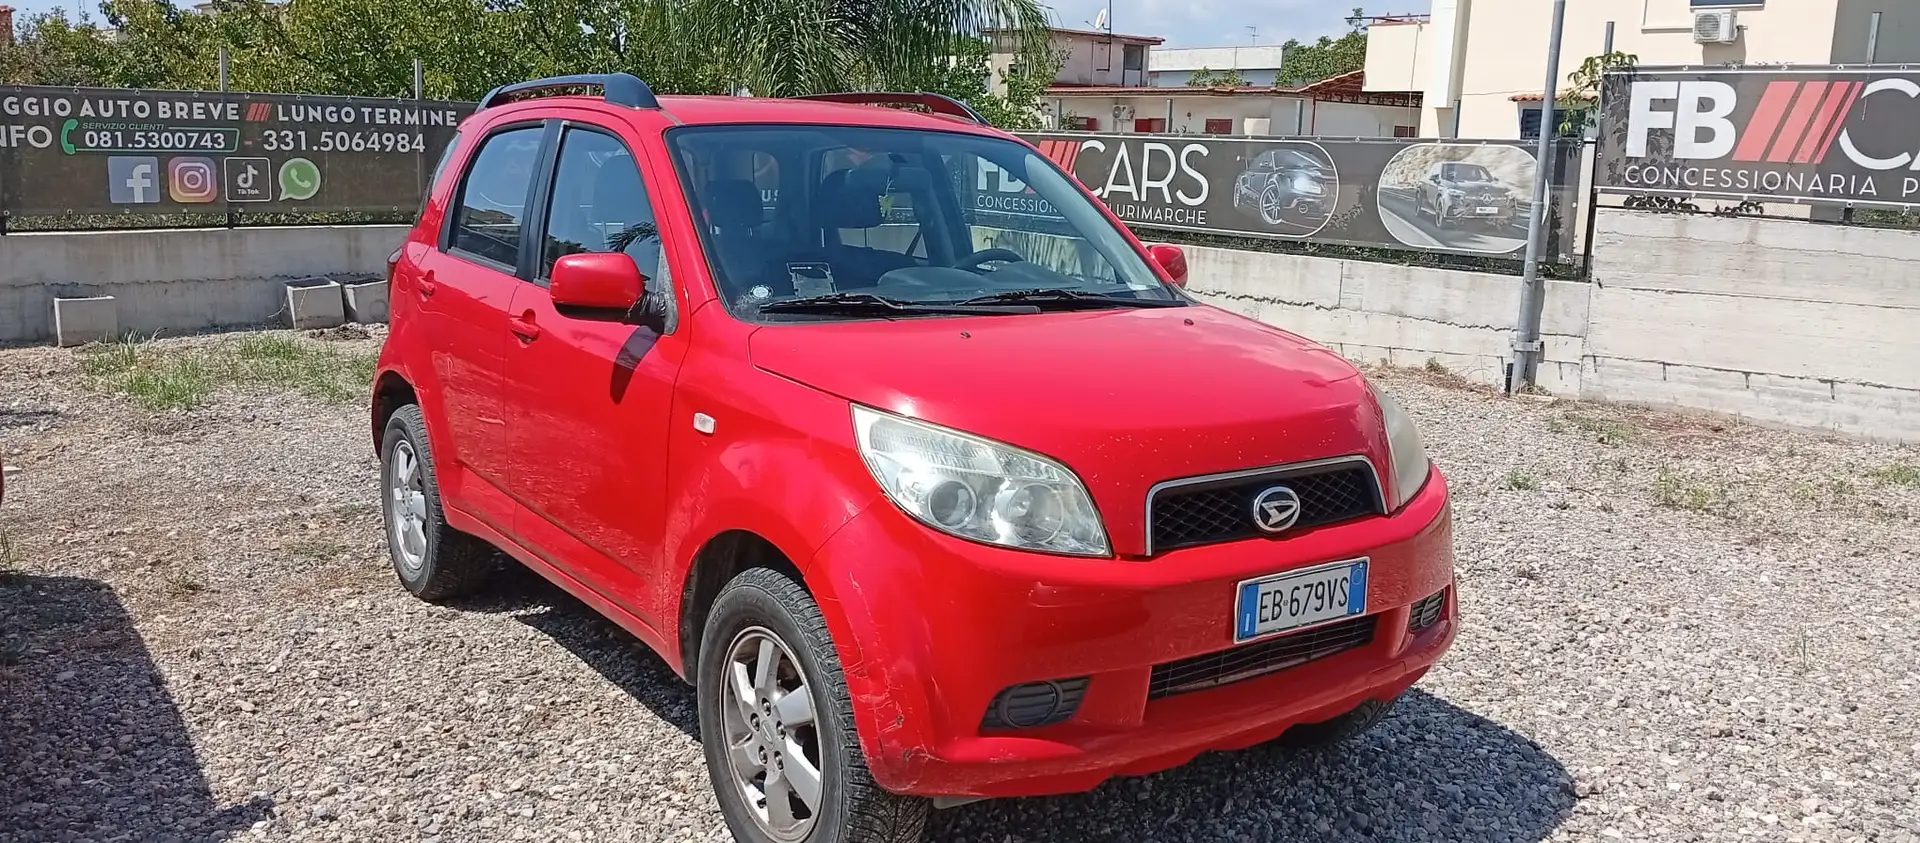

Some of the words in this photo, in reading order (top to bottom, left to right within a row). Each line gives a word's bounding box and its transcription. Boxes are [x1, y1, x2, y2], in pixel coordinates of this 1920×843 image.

[3, 96, 71, 116] GGIO
[79, 98, 150, 118] AUTO
[158, 101, 239, 120] BREVE
[277, 103, 355, 123] LUNGO
[360, 107, 458, 126] TERMINE
[82, 122, 126, 130] SERVIZIO
[128, 123, 164, 131] CLIENTI
[1625, 81, 1737, 160] FB
[1839, 78, 1920, 170] C
[85, 130, 226, 149] 081.5300743
[262, 130, 426, 153] 331.5064984
[1625, 165, 1878, 197] CONCESSIONARIA
[1101, 202, 1207, 225] URIMARCHE
